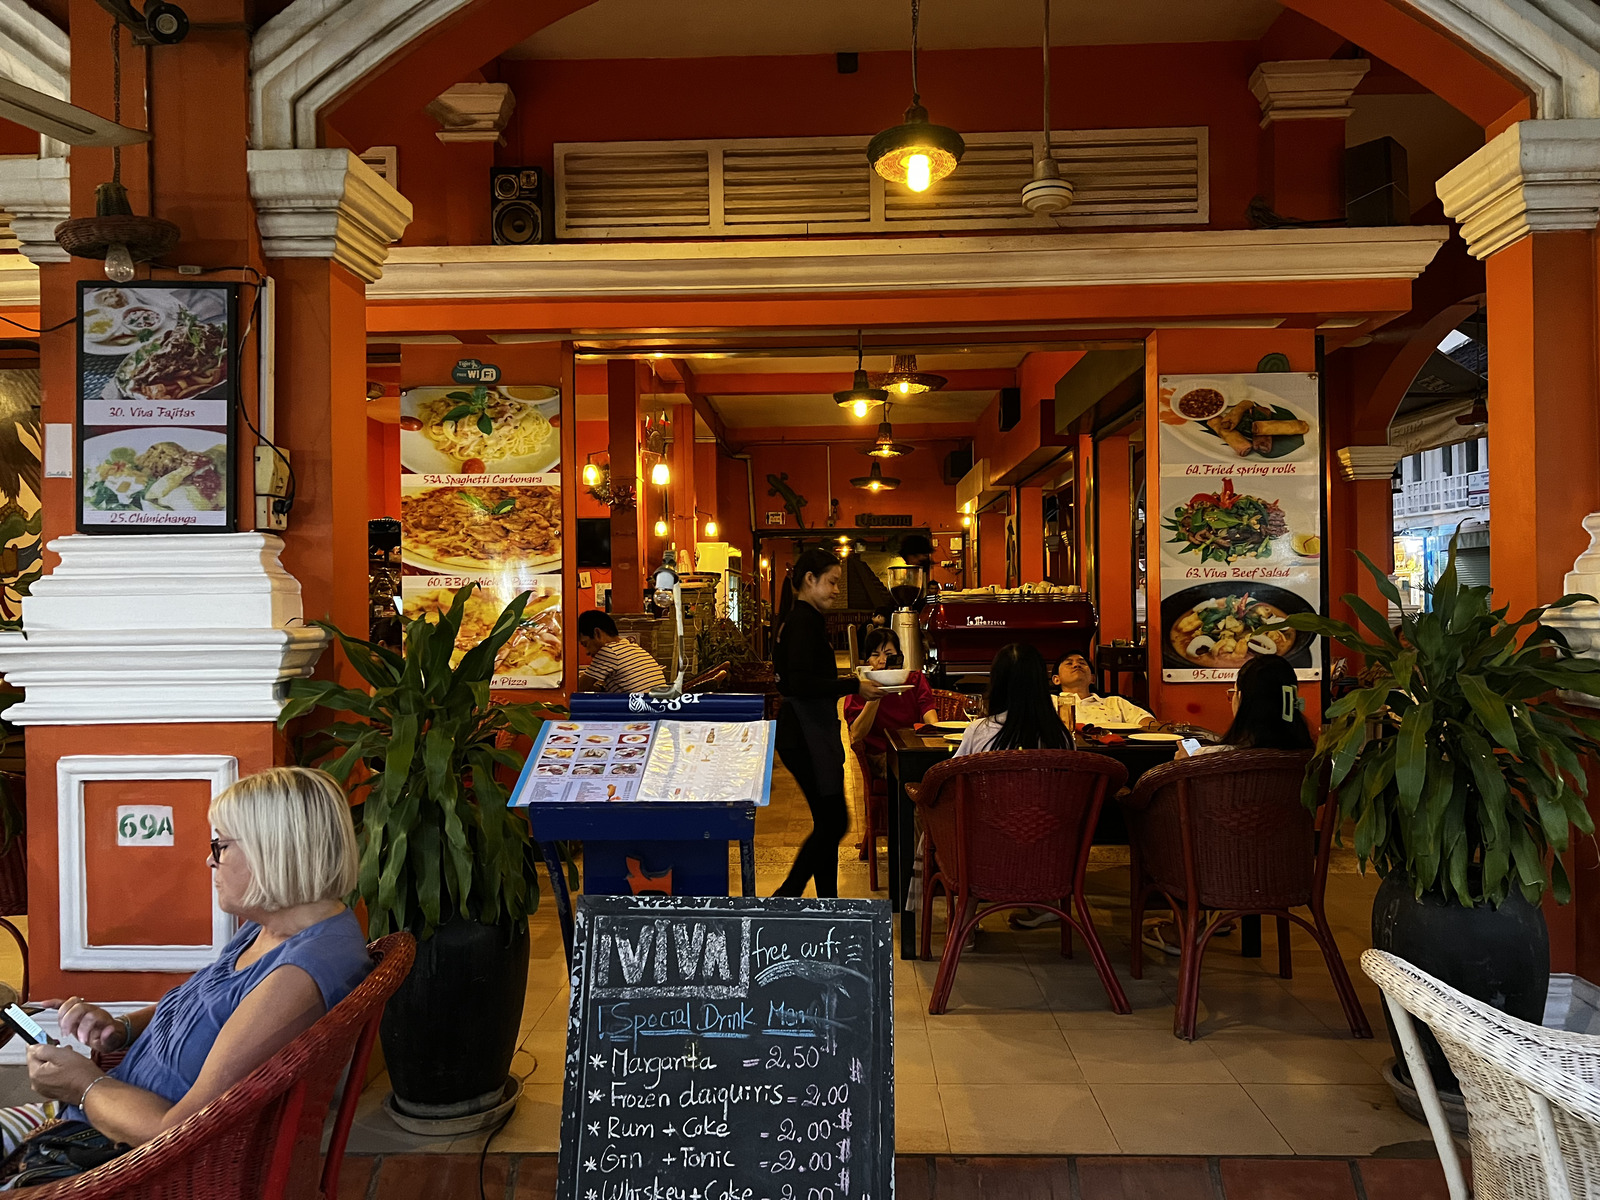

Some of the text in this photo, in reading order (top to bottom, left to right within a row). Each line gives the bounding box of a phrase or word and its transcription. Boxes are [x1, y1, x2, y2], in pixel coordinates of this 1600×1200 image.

[130, 407, 153, 417] Viva
[157, 407, 195, 419] Fajitas
[492, 475, 543, 484] Carbonara
[1203, 464, 1235, 475] Fried
[1236, 464, 1269, 476] spring
[1271, 463, 1296, 474] rolls
[1203, 567, 1227, 578] Viva
[1231, 567, 1260, 579] Beef
[1259, 567, 1291, 578] Salad
[501, 677, 528, 686] Pizza
[650, 692, 703, 711] ger
[119, 813, 174, 840] 69A
[612, 919, 733, 985] VIVA
[751, 926, 791, 968] free
[696, 1000, 757, 1032] Drink
[610, 1081, 671, 1109] Frozen
[679, 1079, 783, 1121] daiquiris
[607, 1115, 655, 1139] Rum
[682, 1115, 731, 1138] Coke
[600, 1143, 643, 1173] Gin
